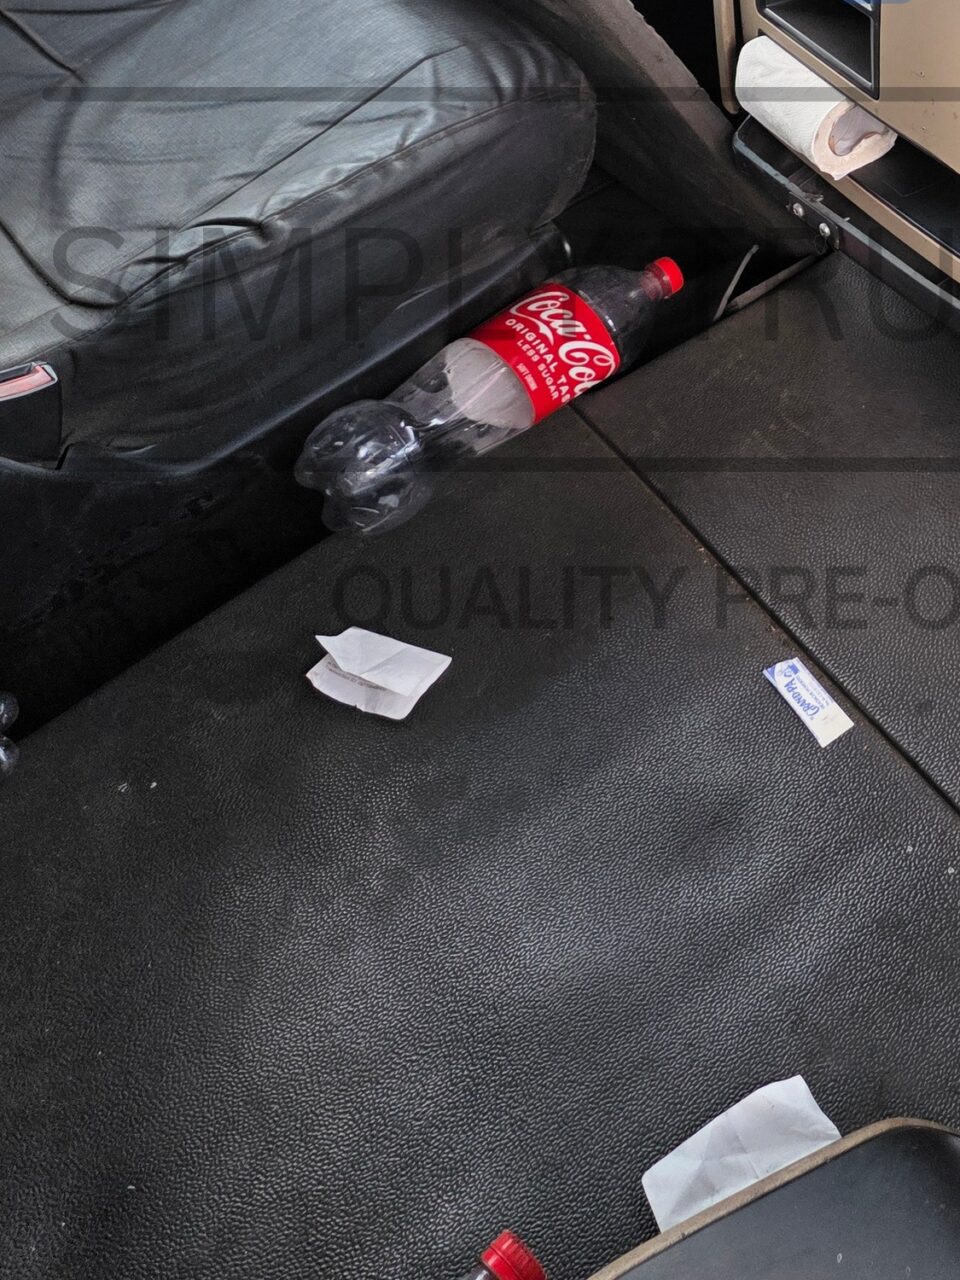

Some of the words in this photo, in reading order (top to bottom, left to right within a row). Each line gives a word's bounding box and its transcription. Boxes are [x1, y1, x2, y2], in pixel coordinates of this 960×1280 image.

[505, 318, 559, 373] ORIGINAL
[517, 339, 540, 362] LESS
[537, 362, 559, 400] SUGAR
[784, 677, 820, 717] GRAND-PA
